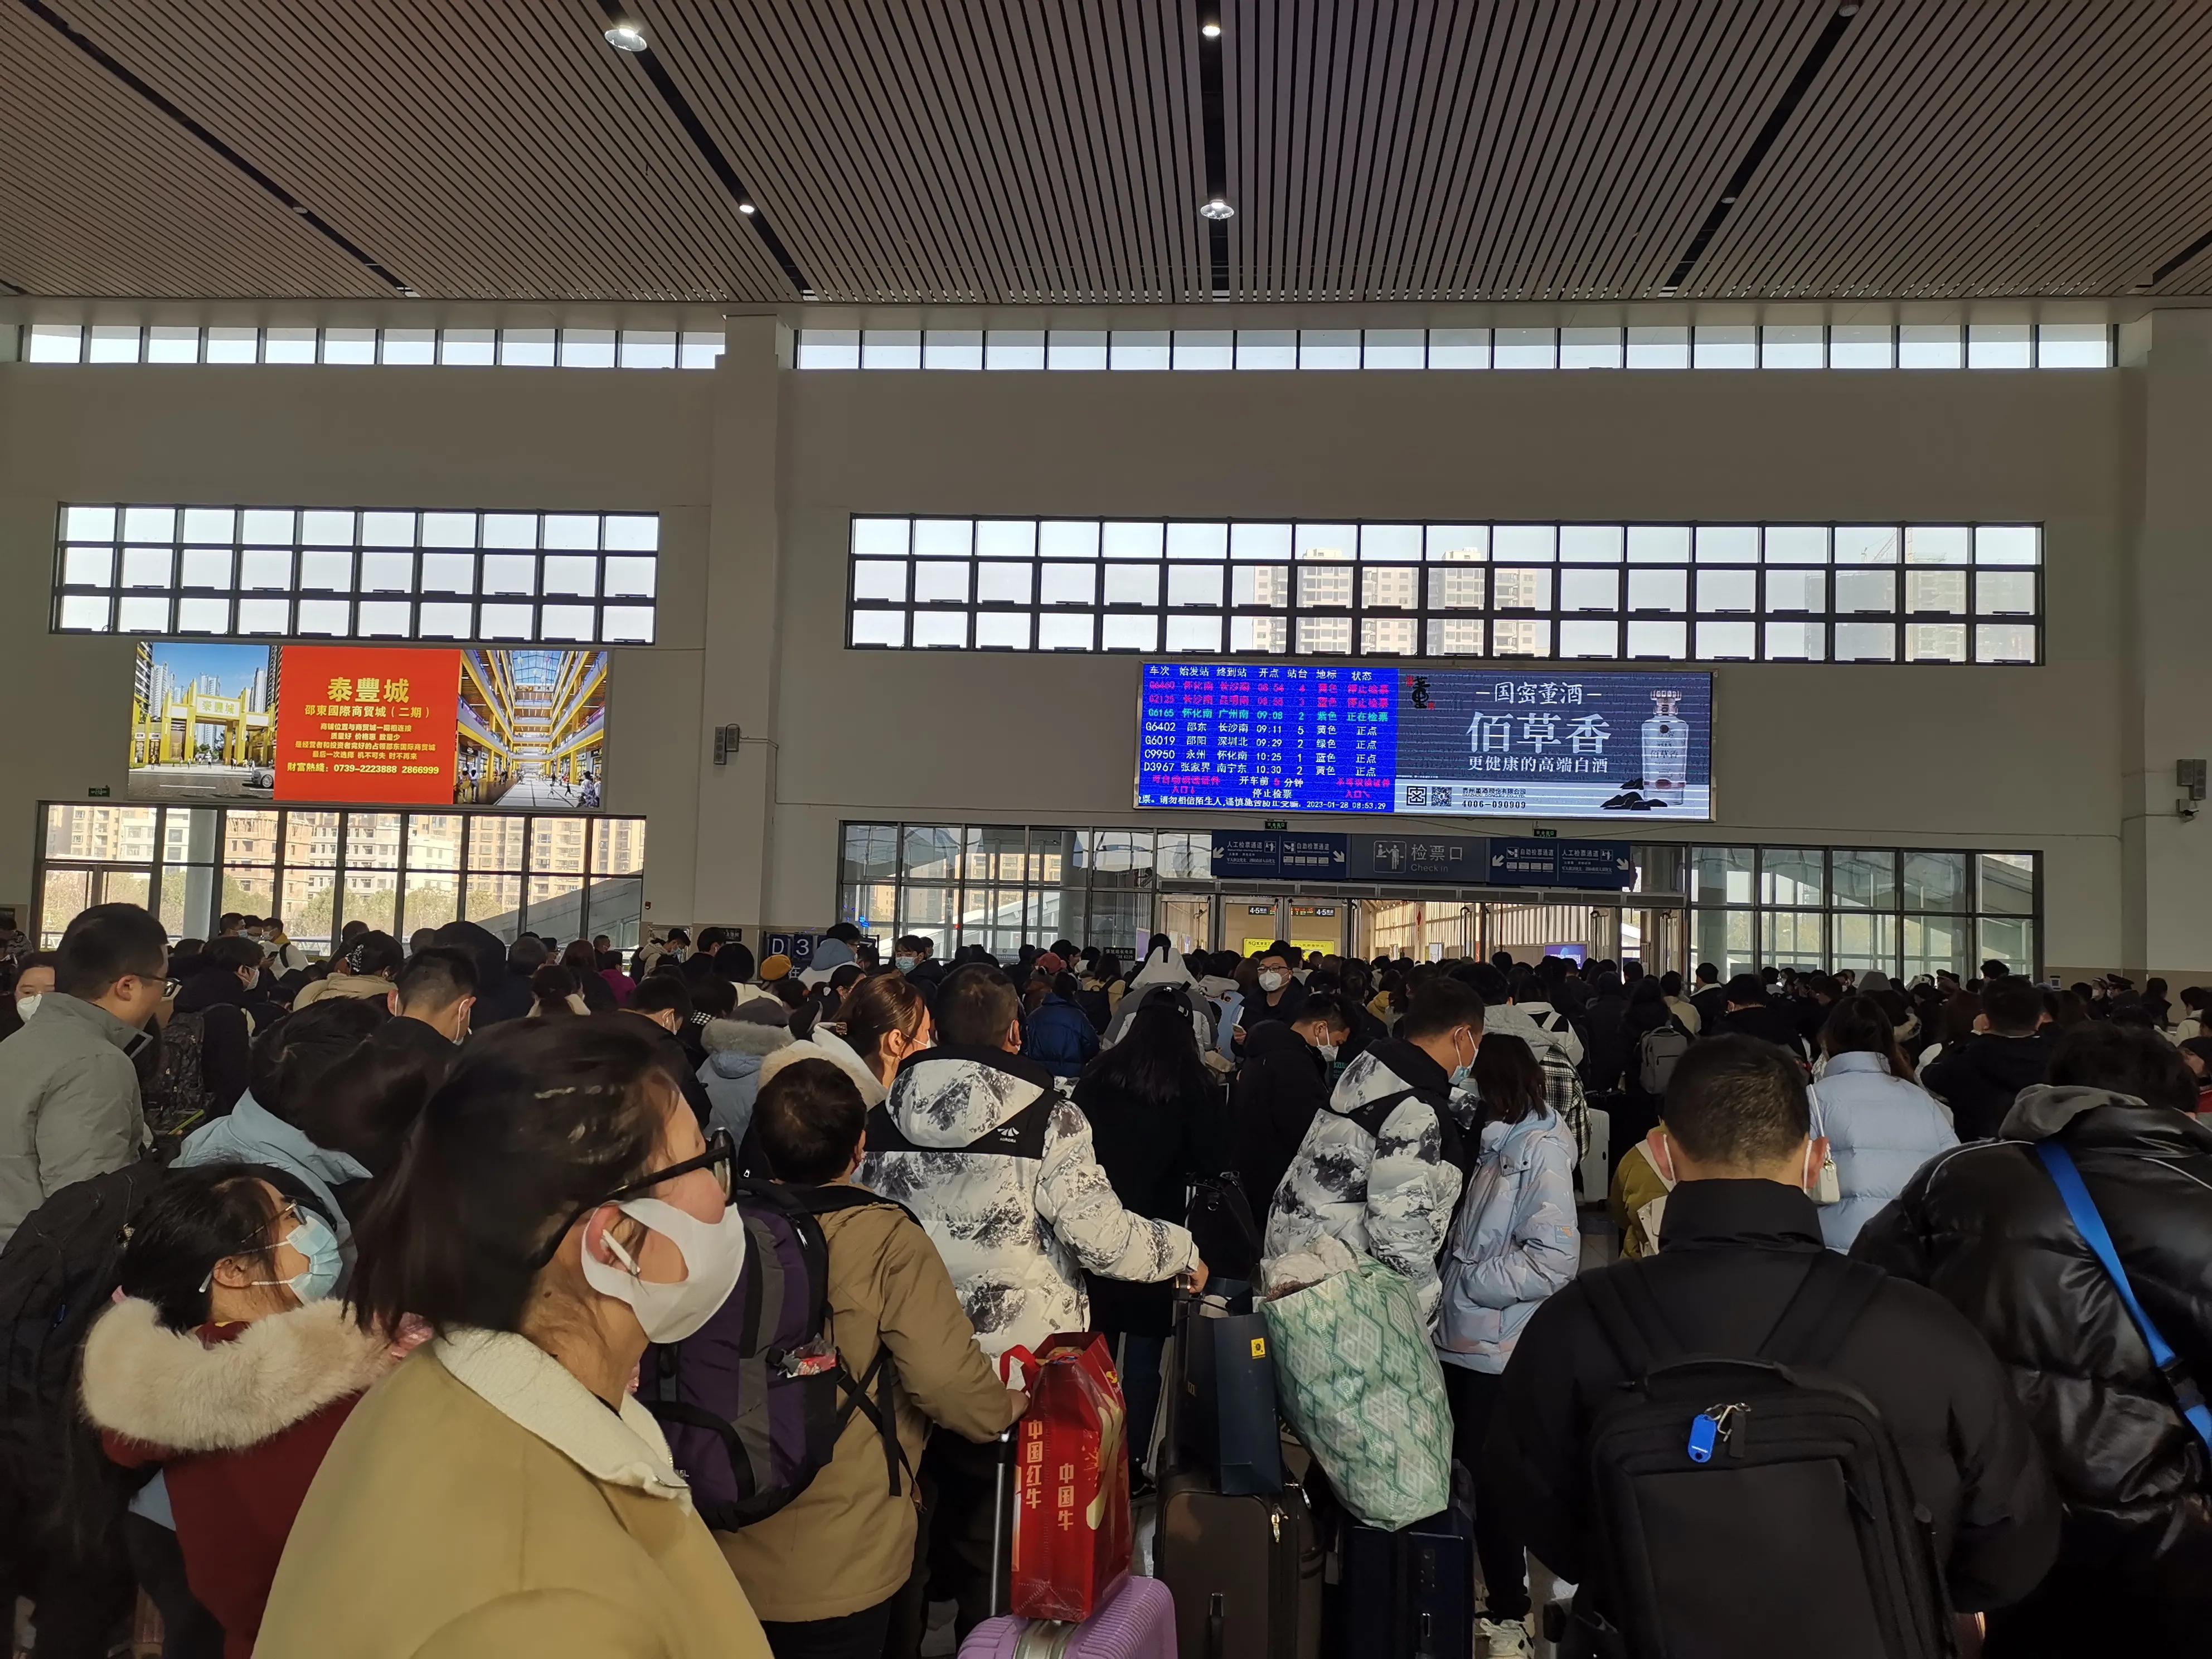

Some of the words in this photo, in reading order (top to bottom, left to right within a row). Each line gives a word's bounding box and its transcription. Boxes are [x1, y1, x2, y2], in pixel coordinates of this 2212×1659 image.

[1149, 666, 1170, 676] 车次
[1180, 666, 1209, 677] 始发站
[1216, 667, 1247, 677] 终到站
[1259, 668, 1279, 678] 开点
[1287, 668, 1308, 679] 站台
[1316, 670, 1337, 680] 地标
[1351, 671, 1372, 681] 状态
[328, 677, 410, 704] 泰豐城
[1219, 681, 1250, 692] 长沙南
[1299, 684, 1306, 692] 4
[1347, 683, 1389, 695] 停止检票
[1495, 681, 1583, 705] 国密董酒
[1347, 697, 1389, 708] 停止检票
[1148, 708, 1174, 717] G6165
[1182, 708, 1212, 719] 怀化南
[1219, 709, 1249, 719] 广州南
[1257, 711, 1283, 720] 09:08
[1298, 712, 1304, 721] 2
[1316, 711, 1337, 721] 紫色
[1347, 711, 1389, 722] 正在检票
[330, 732, 351, 740] 质量好
[1146, 722, 1176, 731] G6402
[1187, 722, 1207, 732] 邵东
[1218, 722, 1249, 733] 长沙南
[1257, 725, 1282, 734] 09:11
[1297, 726, 1304, 735] 5
[1316, 725, 1337, 735] 黄色
[1356, 726, 1377, 736] 正点
[1466, 711, 1612, 754] 佰草香
[1145, 735, 1176, 745] G6019
[1186, 736, 1207, 746] 邵阳
[1217, 736, 1249, 746] 深圳北
[1257, 739, 1282, 747] 09:29
[1297, 739, 1304, 749] 2
[1316, 739, 1337, 749] 绿色
[1356, 740, 1377, 750] 正点
[313, 750, 355, 759] 最后一次选择
[1144, 749, 1175, 759] C9950
[1186, 749, 1206, 759] 永州
[1217, 750, 1248, 760] 怀化南
[1257, 753, 1282, 761] 10:25
[1298, 753, 1302, 762] 1
[1315, 753, 1336, 763] 蓝色
[1355, 753, 1376, 764] 正点
[333, 764, 397, 773] 0739-2223888
[401, 765, 439, 774] 2866999
[1144, 762, 1175, 772] D3967
[1181, 762, 1210, 773] 张家界
[1217, 763, 1247, 774] 南宁东
[1256, 766, 1282, 774] 10:30
[1296, 767, 1303, 775] 2
[1316, 766, 1336, 776] 黄色
[1355, 767, 1376, 777] 正点
[1468, 755, 1608, 773] 更健康的高端白酒
[1239, 776, 1269, 786] 开车前
[1274, 778, 1280, 787] 5
[1284, 778, 1304, 788] 分钟
[1252, 788, 1293, 799] 停止检票
[1306, 801, 1349, 809] 2023-01-28
[1462, 799, 1526, 809] 4006-090909
[1226, 841, 1263, 849] 人工检票通道
[1411, 844, 1463, 862] 检票口
[1520, 848, 1554, 857] 自助检票通道
[1561, 849, 1599, 857] 人工检票通道
[1411, 864, 1439, 872] Check
[1026, 1419, 1043, 1509] 中国红牛
[1058, 1463, 1074, 1531] 中国牛
